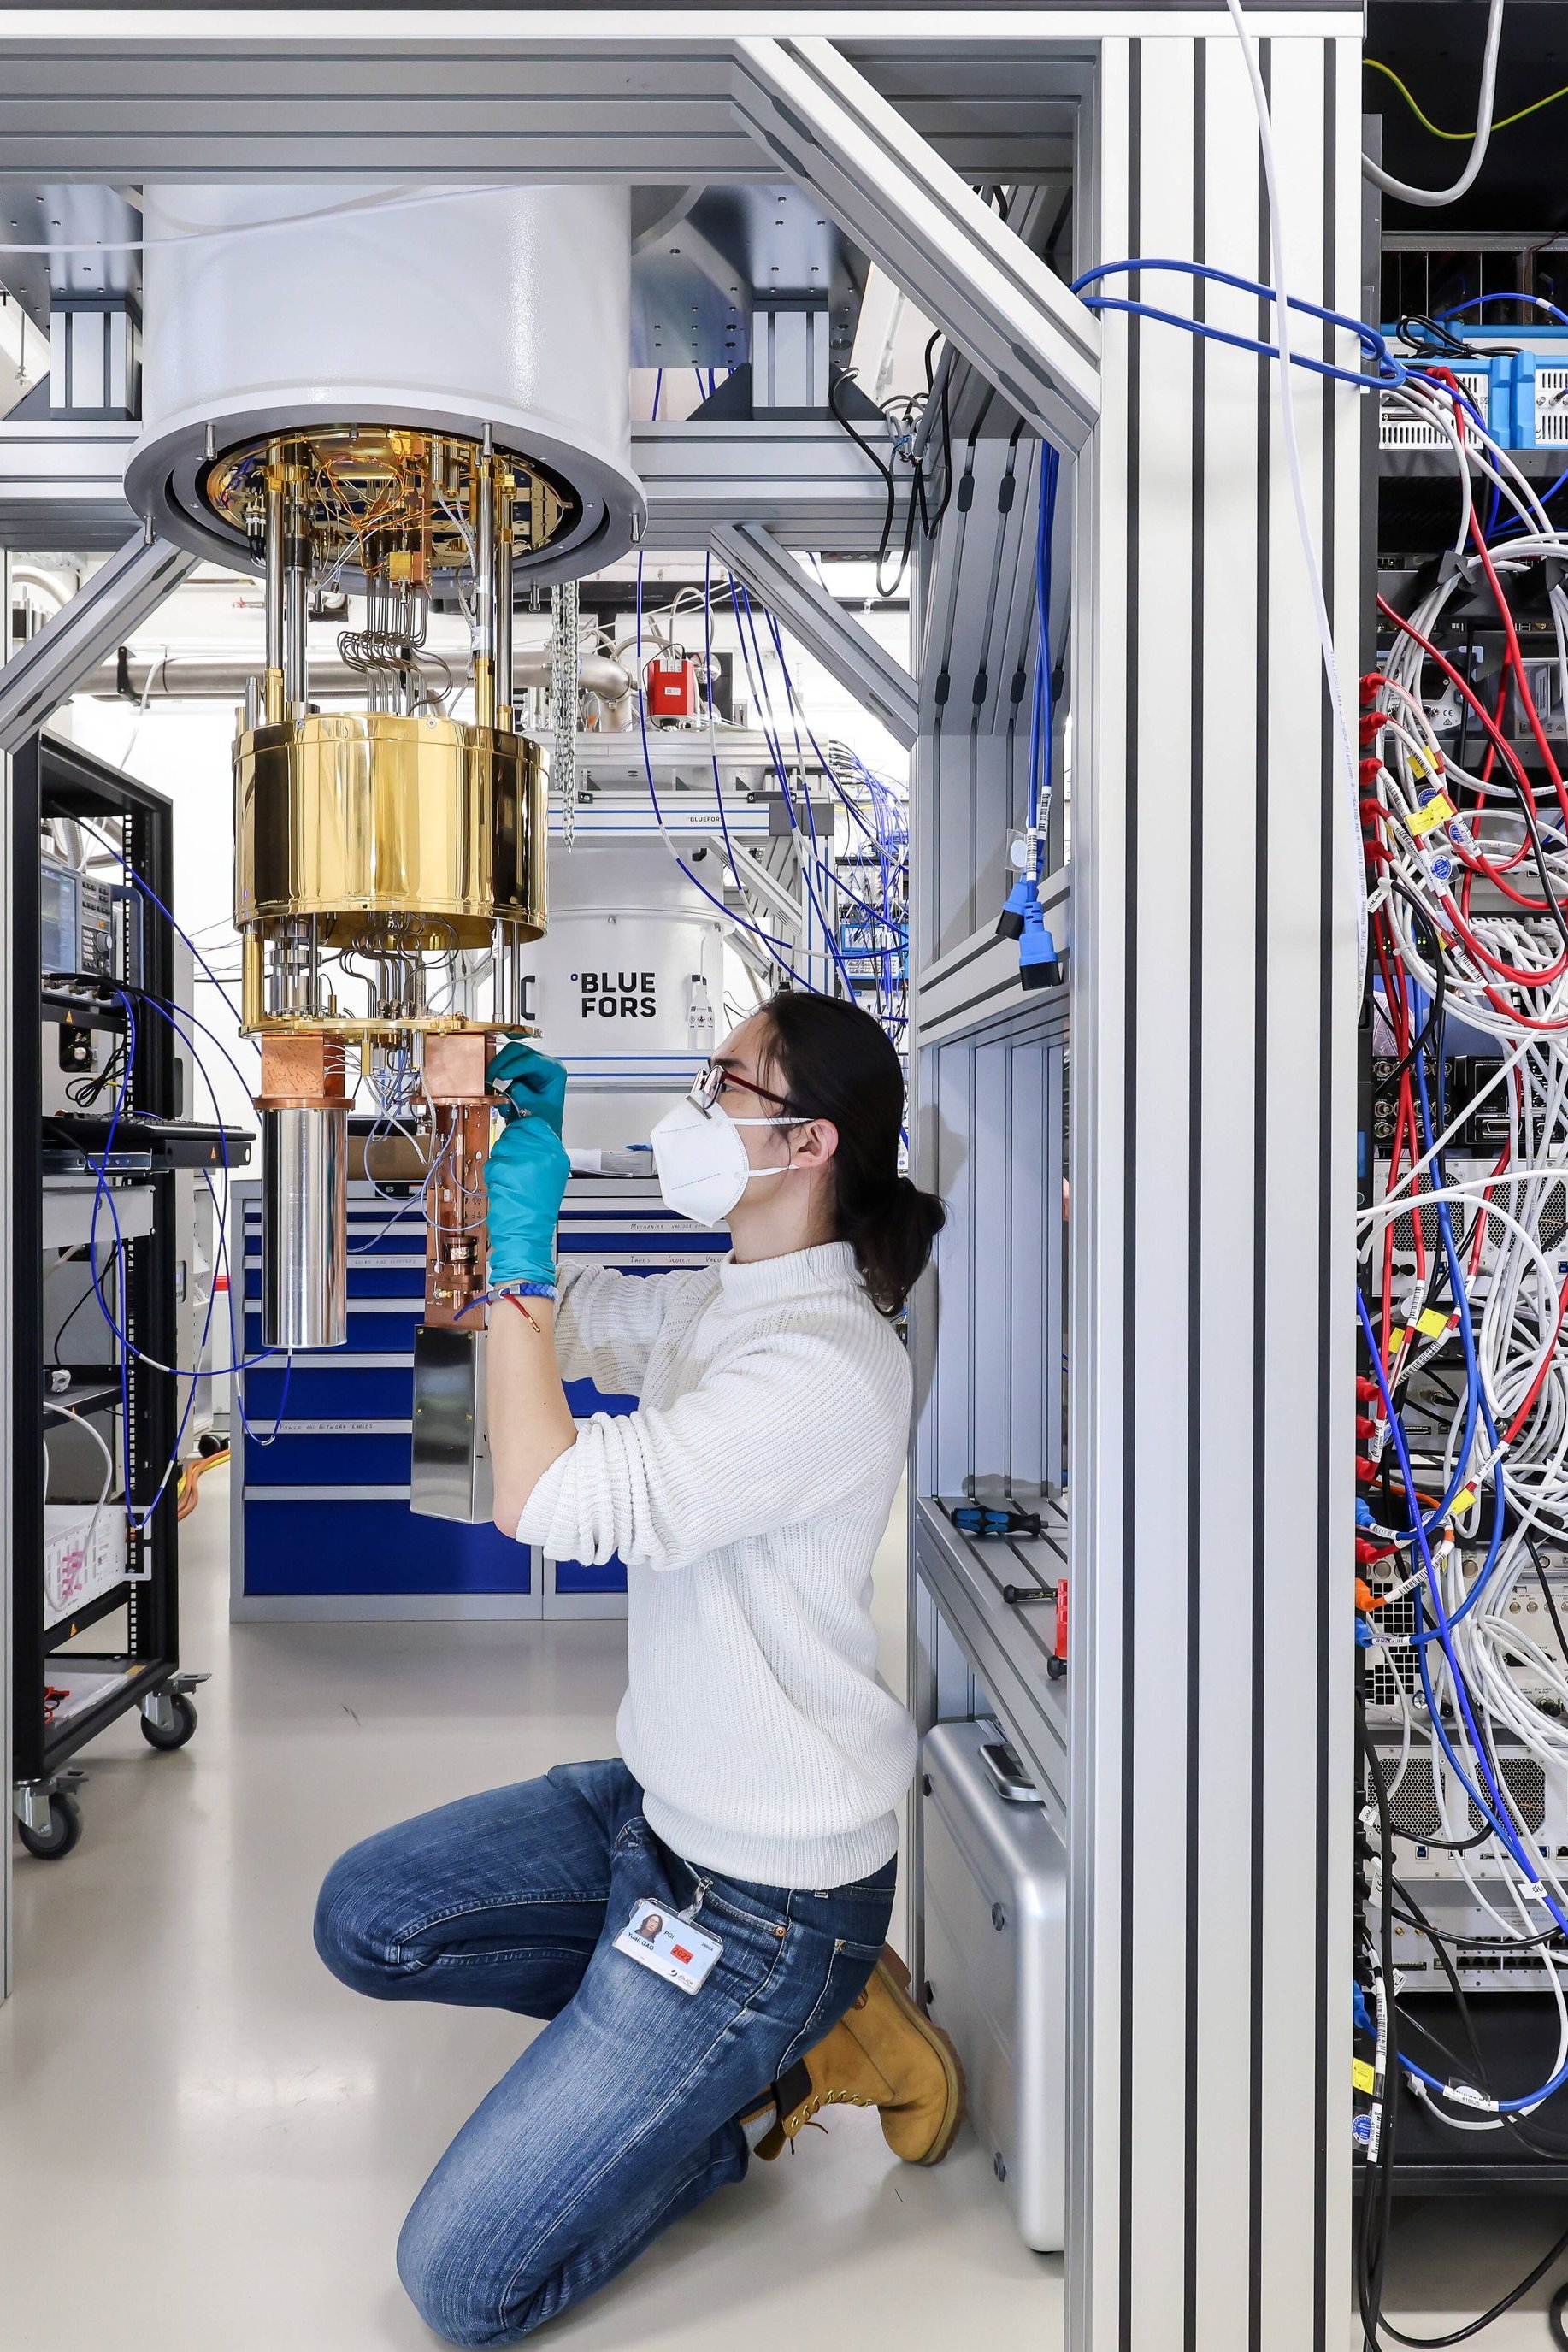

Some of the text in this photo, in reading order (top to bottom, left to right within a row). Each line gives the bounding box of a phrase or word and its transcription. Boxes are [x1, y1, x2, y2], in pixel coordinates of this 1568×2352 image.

[581, 972, 656, 993] BLUE
[581, 997, 657, 1018] FORS
[628, 1932, 655, 1951] Yuan GAO
[663, 1931, 675, 1939] PGI
[672, 1948, 692, 1962] 2022
